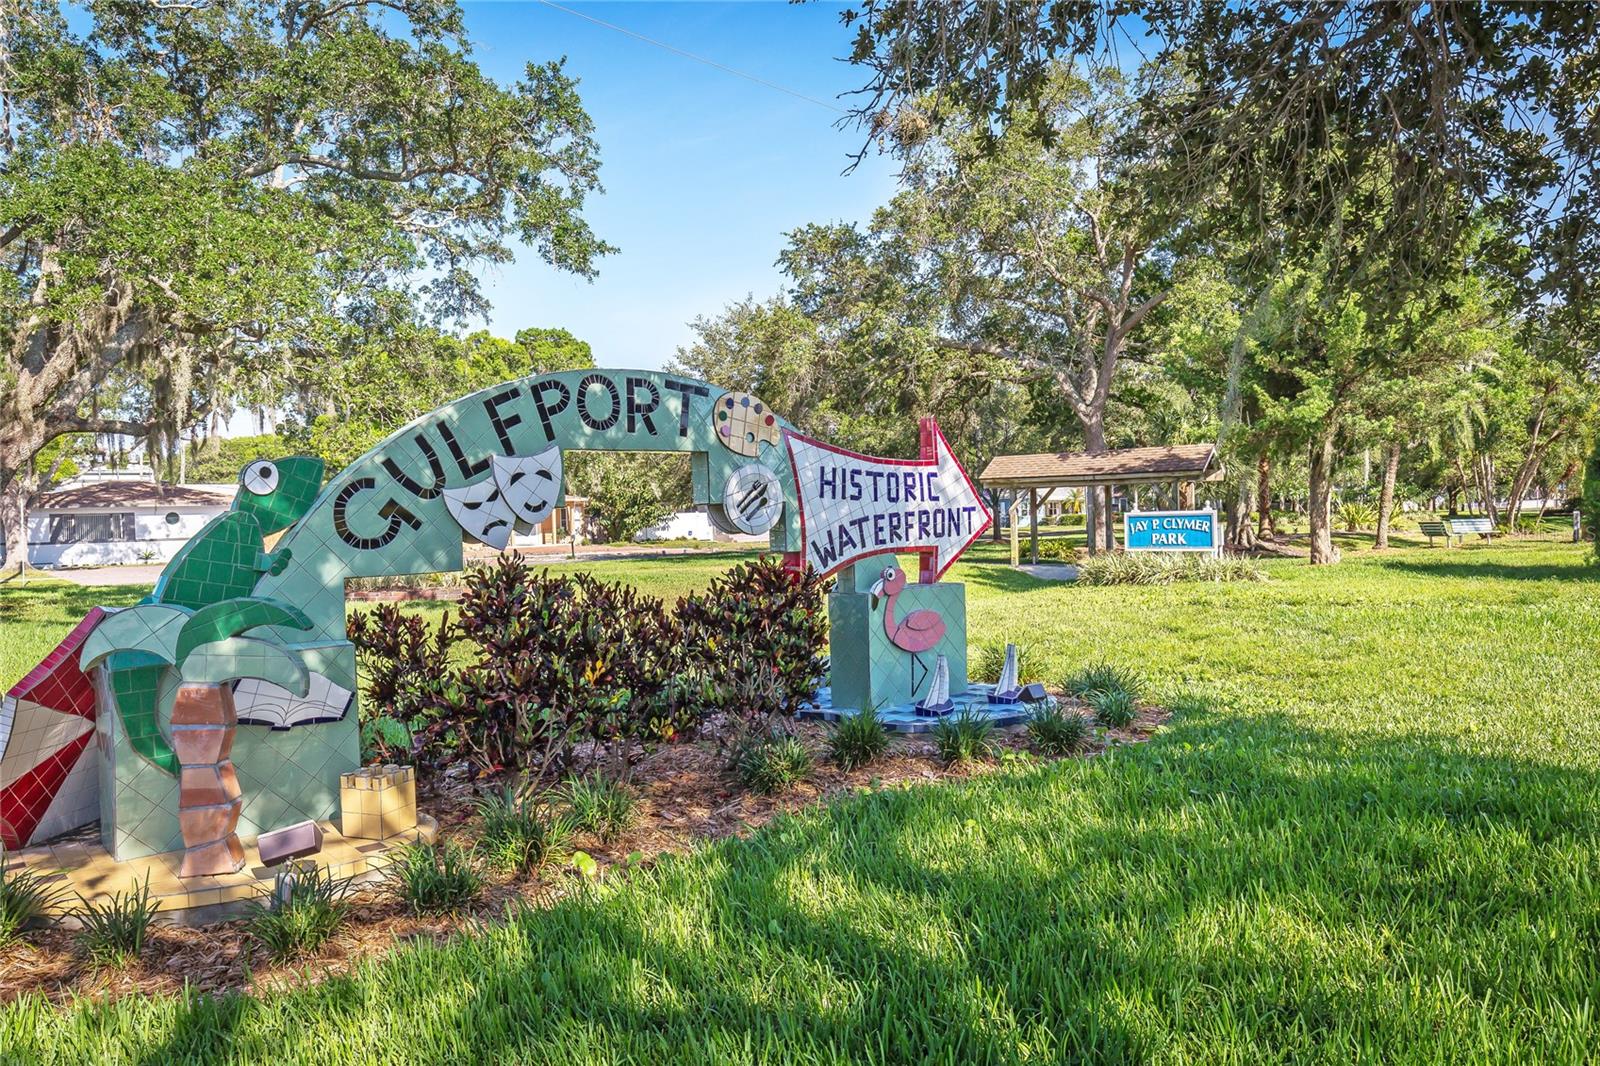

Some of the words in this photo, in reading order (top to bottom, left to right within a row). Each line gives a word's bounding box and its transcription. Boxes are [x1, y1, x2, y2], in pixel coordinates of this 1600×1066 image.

[333, 373, 709, 550] GULFPORT
[819, 466, 940, 503] HISTORIC
[811, 506, 976, 569] WATERFRONT
[1130, 520, 1148, 534] JAY
[1163, 518, 1210, 532] CLYMER
[1152, 533, 1187, 545] PARK
